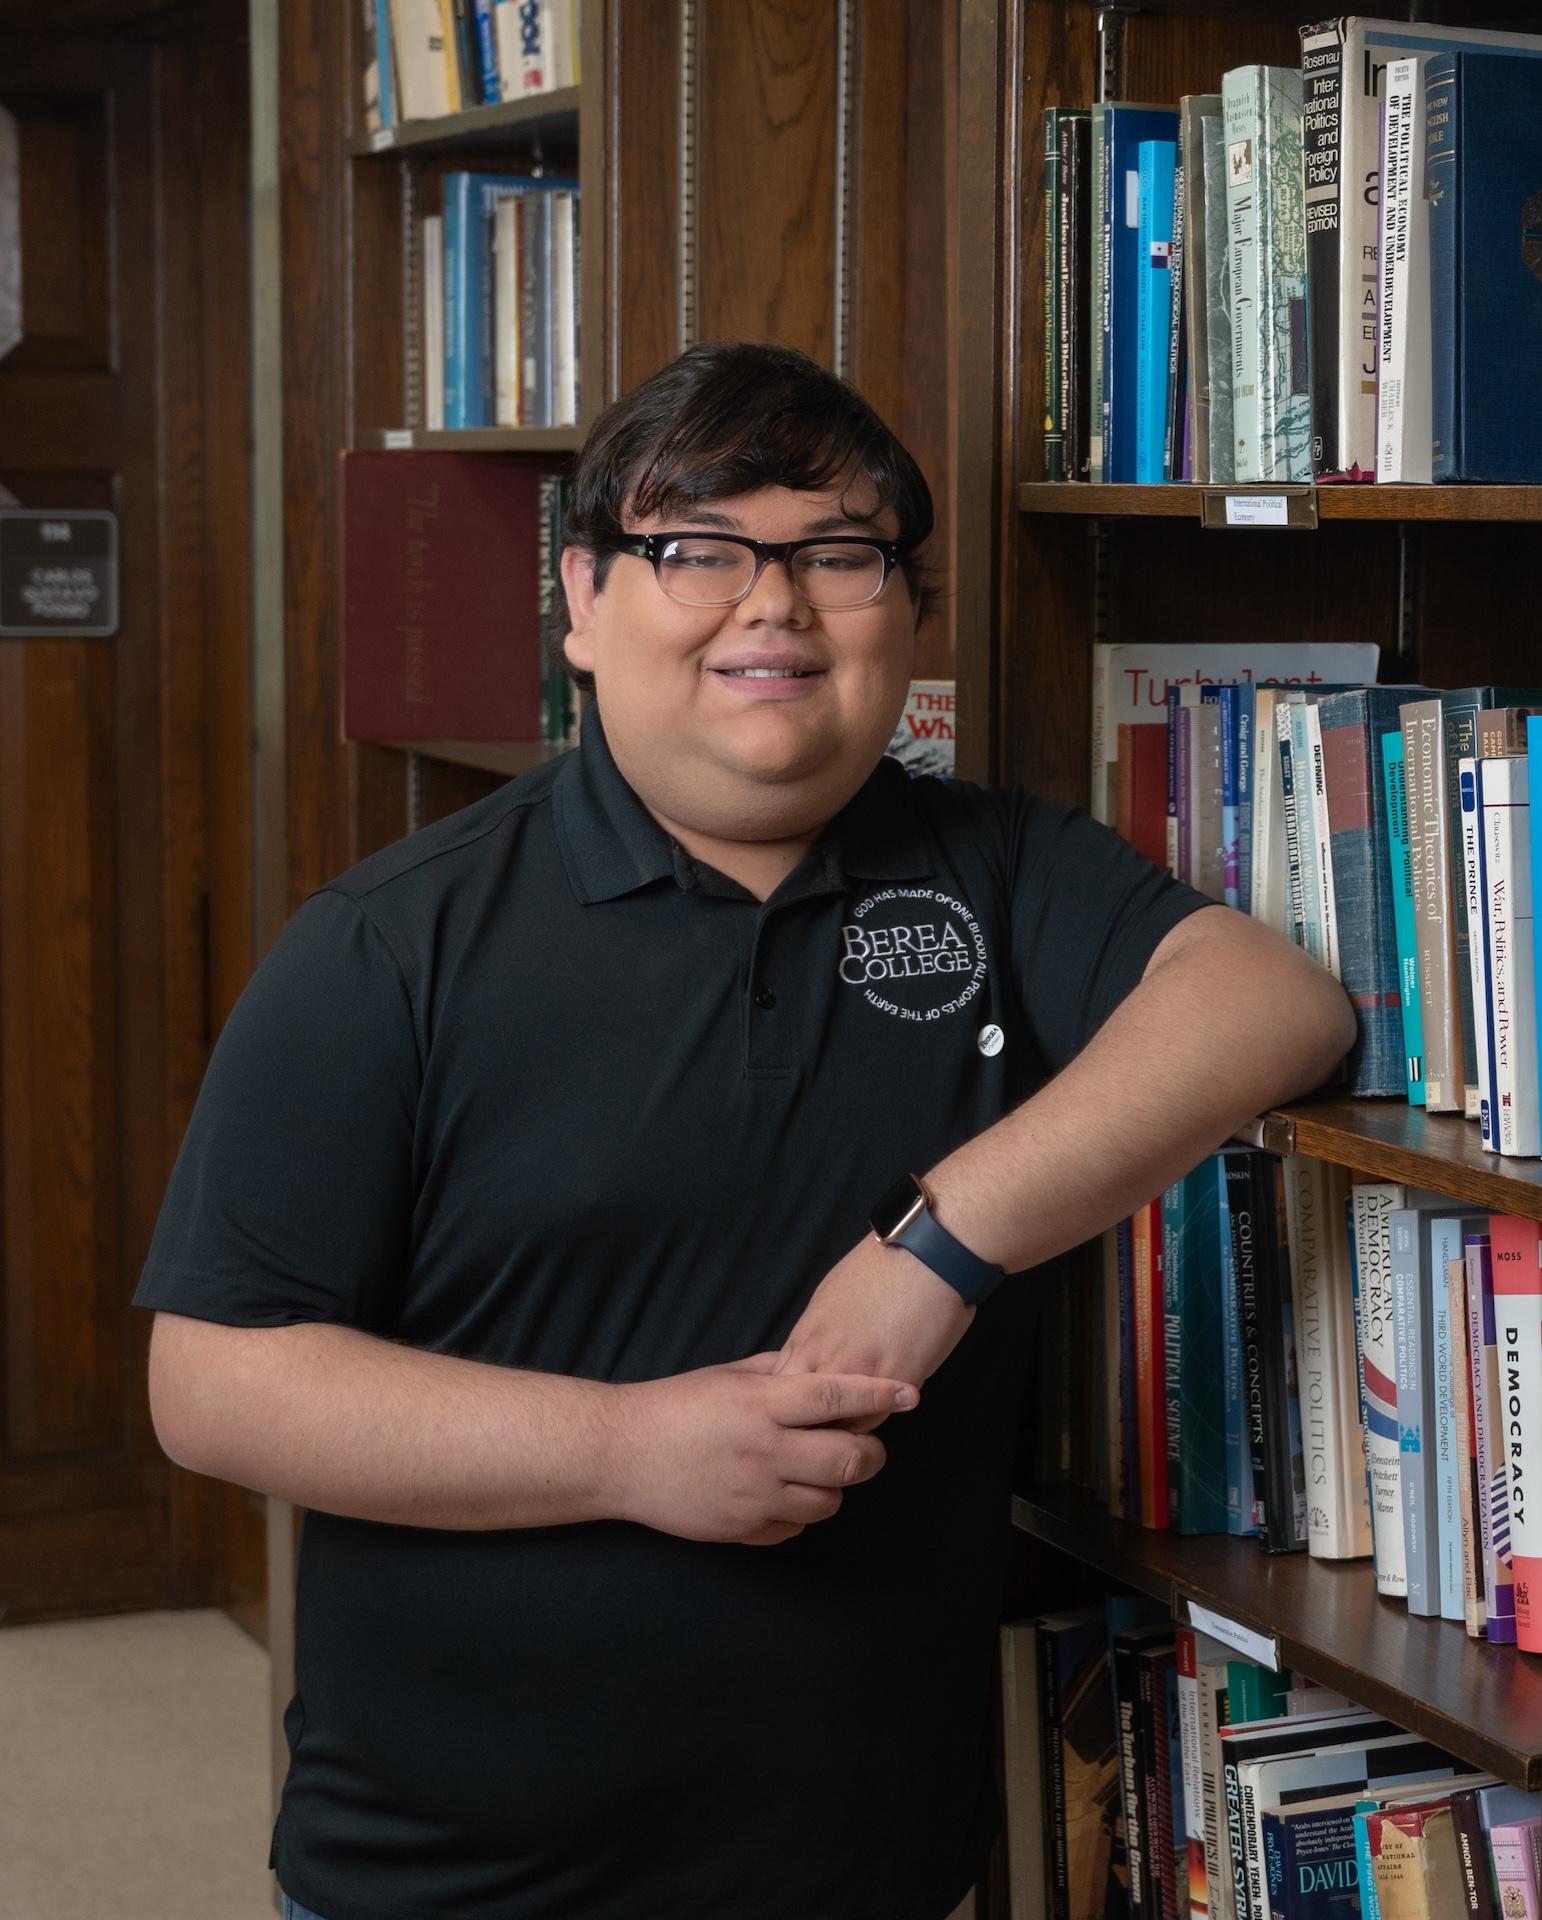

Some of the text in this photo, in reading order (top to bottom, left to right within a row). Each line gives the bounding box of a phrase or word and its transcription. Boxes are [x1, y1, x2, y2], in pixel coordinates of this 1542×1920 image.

[1303, 52, 1340, 70] Rosenau
[1303, 93, 1339, 116] national
[1313, 79, 1340, 96] Inter-
[1305, 112, 1339, 133] Politics
[1317, 128, 1339, 147] and
[1304, 148, 1339, 169] Foreign
[1308, 165, 1338, 185] Policy
[1396, 93, 1412, 263] THE POLITICAL ECONOMY
[1231, 195, 1253, 235] Major
[1307, 217, 1338, 235] EDITION
[1383, 95, 1400, 364] OF DEVELOPMENT AND UNDERDEVELOPMENT
[1169, 166, 1184, 374] UNDERSTANDING TECHNOLOGICAL POLITICS
[1231, 237, 1253, 295] European
[1061, 193, 1069, 430] Justice and Economic Distribution
[1096, 311, 1104, 371] ANALYSIS
[1234, 297, 1254, 378] Governments
[1233, 498, 1283, 509] International Political
[1234, 512, 1256, 524] Economy
[913, 694, 955, 711] THE
[1238, 714, 1249, 793] Craig and George
[1295, 721, 1304, 748] OLSON
[1459, 719, 1473, 752] The
[1296, 760, 1308, 790] How
[1313, 744, 1324, 796] DEFINING
[1447, 721, 1460, 808] of Nations
[1298, 794, 1309, 816] the
[1388, 761, 1400, 838] Development
[1405, 719, 1423, 911] International Politics
[1421, 717, 1442, 922] Economic Theories of
[1239, 802, 1251, 854] FORCE AND
[1282, 755, 1304, 923] KEGLEY INTERNATIONAL TERRORISM
[1300, 819, 1313, 861] World
[1398, 760, 1413, 897] Understanding Political
[1493, 812, 1502, 864] Clausewitz
[1303, 866, 1315, 910] Works
[1466, 824, 1478, 915] THE PRINCE
[841, 921, 968, 959] BEREA
[854, 888, 988, 1021] GOD HAS MADE OF ONE BLOOD ALL PEOPLES OF THE EARTH
[838, 950, 973, 985] COLLEGE
[1402, 956, 1411, 1006] Huntington
[1408, 956, 1416, 988] Weiner
[1424, 948, 1432, 1007] RUSSETT
[1491, 879, 1510, 1069] War, Politics, and Power
[1238, 1211, 1257, 1319] COUNTRIES
[1357, 1195, 1371, 1339] in World Perspective
[1366, 1195, 1384, 1348] DEMOCRACY
[1380, 1194, 1394, 1322] AMERICAN
[1441, 1237, 1449, 1288] HANDELMAN
[1497, 1251, 1522, 1261] MOSS
[1166, 1295, 1173, 1308] TO
[1229, 1257, 1239, 1401] COMPARATIVE POLITICS
[1246, 1325, 1257, 1338] &
[1298, 1170, 1328, 1485] COMPARATIVE POLITICS
[1396, 1273, 1408, 1390] COMPARATIVE POLITICS
[1406, 1273, 1417, 1390] ESSENTIAL READINGS IN
[1164, 1313, 1181, 1462] POLITICAL SCIENCE
[1247, 1344, 1265, 1443] CONCEPTS
[1437, 1310, 1450, 1462] THIRD WORLD DEVELOPMENT
[1471, 1311, 1489, 1550] DEMOCRACY AND DEMOCRATIZATION
[1505, 1327, 1524, 1525] DEMOCRACY
[1371, 1453, 1400, 1466] Ebenstein
[1373, 1469, 1399, 1481] Pritchett
[1375, 1485, 1395, 1498] Turner
[1376, 1502, 1394, 1513] Mann
[1462, 1518, 1470, 1548] Allyn
[1465, 1576, 1473, 1600] Bac
[1180, 1690, 1187, 1699] of
[1182, 1721, 1190, 1759] Middle
[1188, 1690, 1202, 1818] International Relations
[1184, 1761, 1192, 1787] East
[1203, 1771, 1216, 1798] THE
[1120, 1700, 1142, 1904] The Turban for the Crown
[1224, 1763, 1244, 1861] GREATER
[1244, 1785, 1258, 1863] CONTEMPORARY
[1311, 1817, 1342, 1828] interviewed
[1204, 1799, 1219, 1861] POLITICS
[1295, 1829, 1327, 1839] understand
[1295, 1838, 1323, 1848] absolutely
[1459, 1832, 1472, 1867] AMNON
[1208, 1861, 1219, 1878] OF
[1250, 1866, 1262, 1901] YEMEN:
[1266, 1831, 1278, 1896] PRYCE-JONES
[1274, 1850, 1283, 1882] DAVID
[1298, 1859, 1358, 1894] DAVID
[1364, 1841, 1374, 1893] THE FIRST
[1465, 1868, 1479, 1910] BEN-TOR
